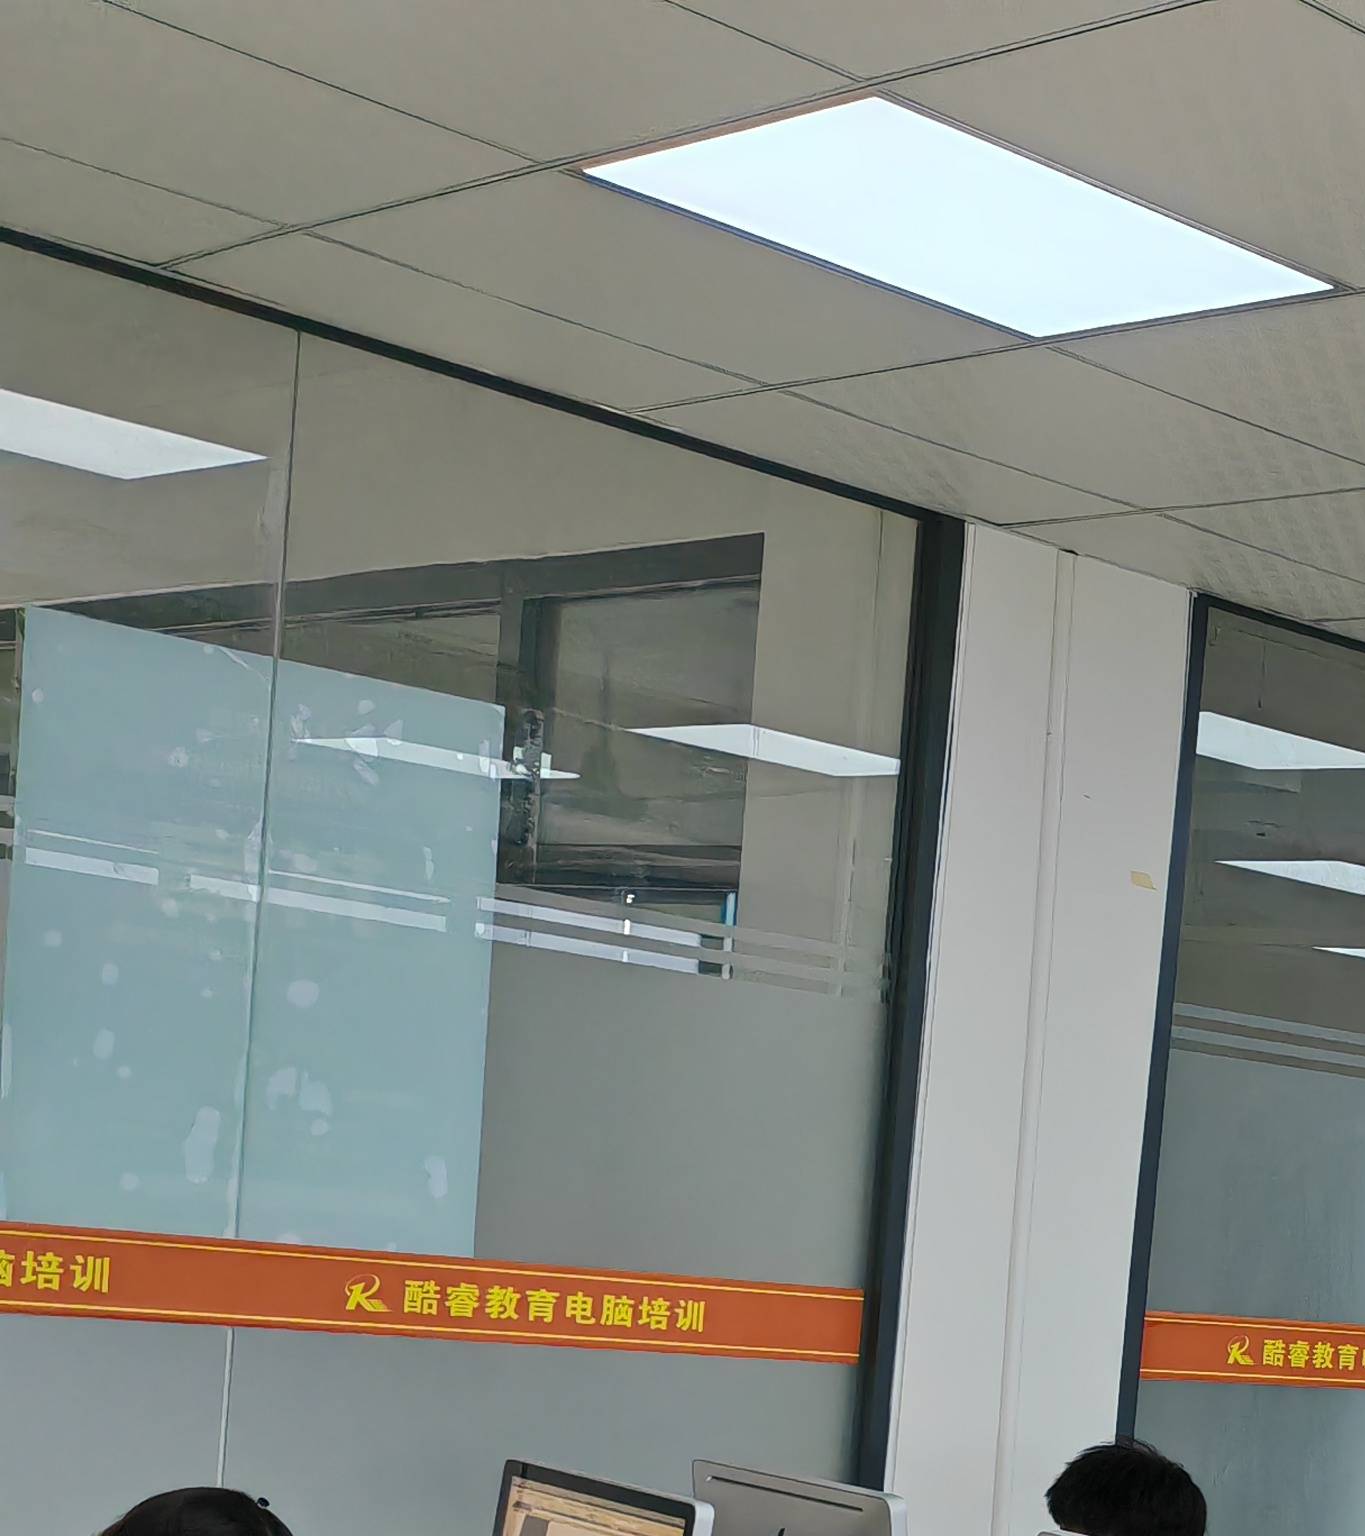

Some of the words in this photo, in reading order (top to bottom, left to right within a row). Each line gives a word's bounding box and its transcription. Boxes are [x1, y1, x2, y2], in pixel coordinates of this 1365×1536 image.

[403, 1280, 705, 1333] 酷睿教育电脑培训
